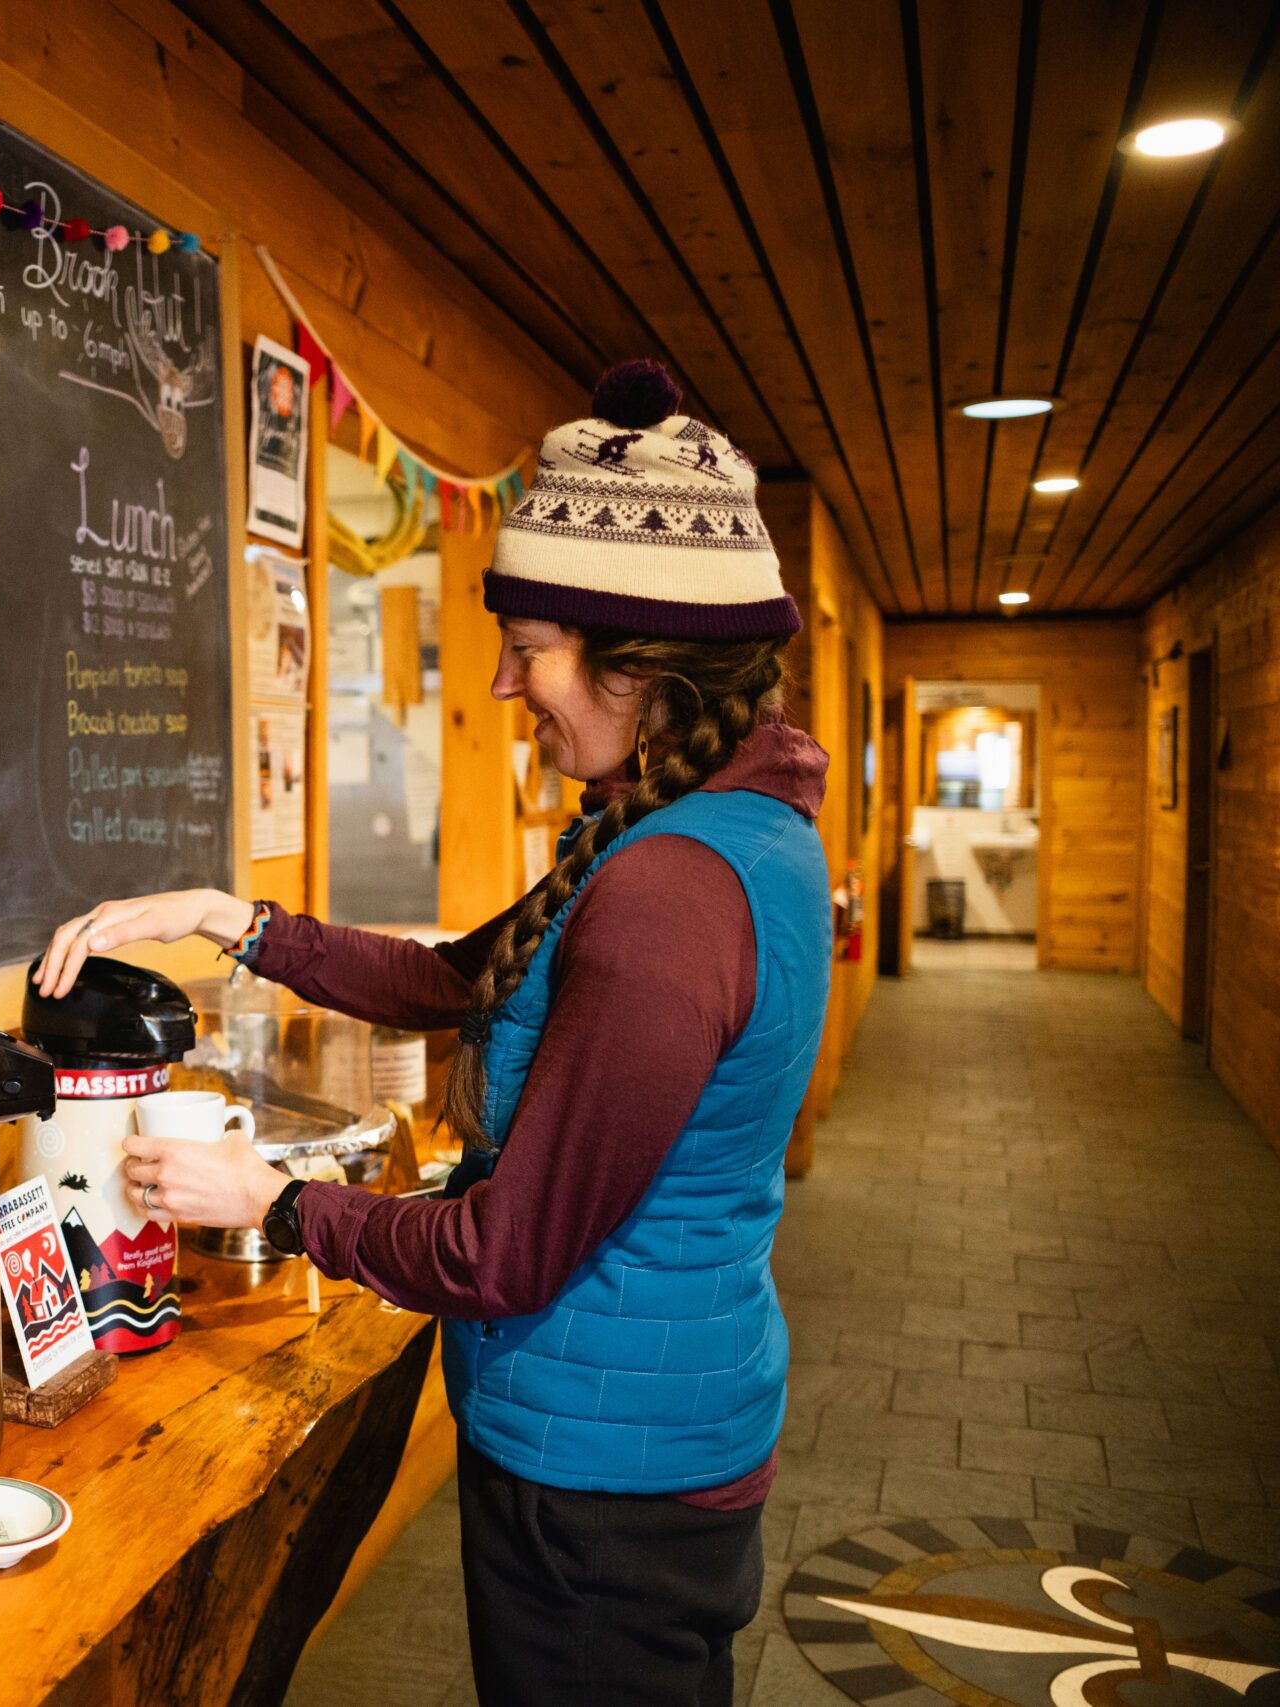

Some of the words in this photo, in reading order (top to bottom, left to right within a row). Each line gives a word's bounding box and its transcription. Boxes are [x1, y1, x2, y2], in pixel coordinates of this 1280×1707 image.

[22, 181, 122, 328] Brook
[21, 307, 43, 341] up
[48, 308, 68, 340] to
[70, 446, 177, 562] Lunch
